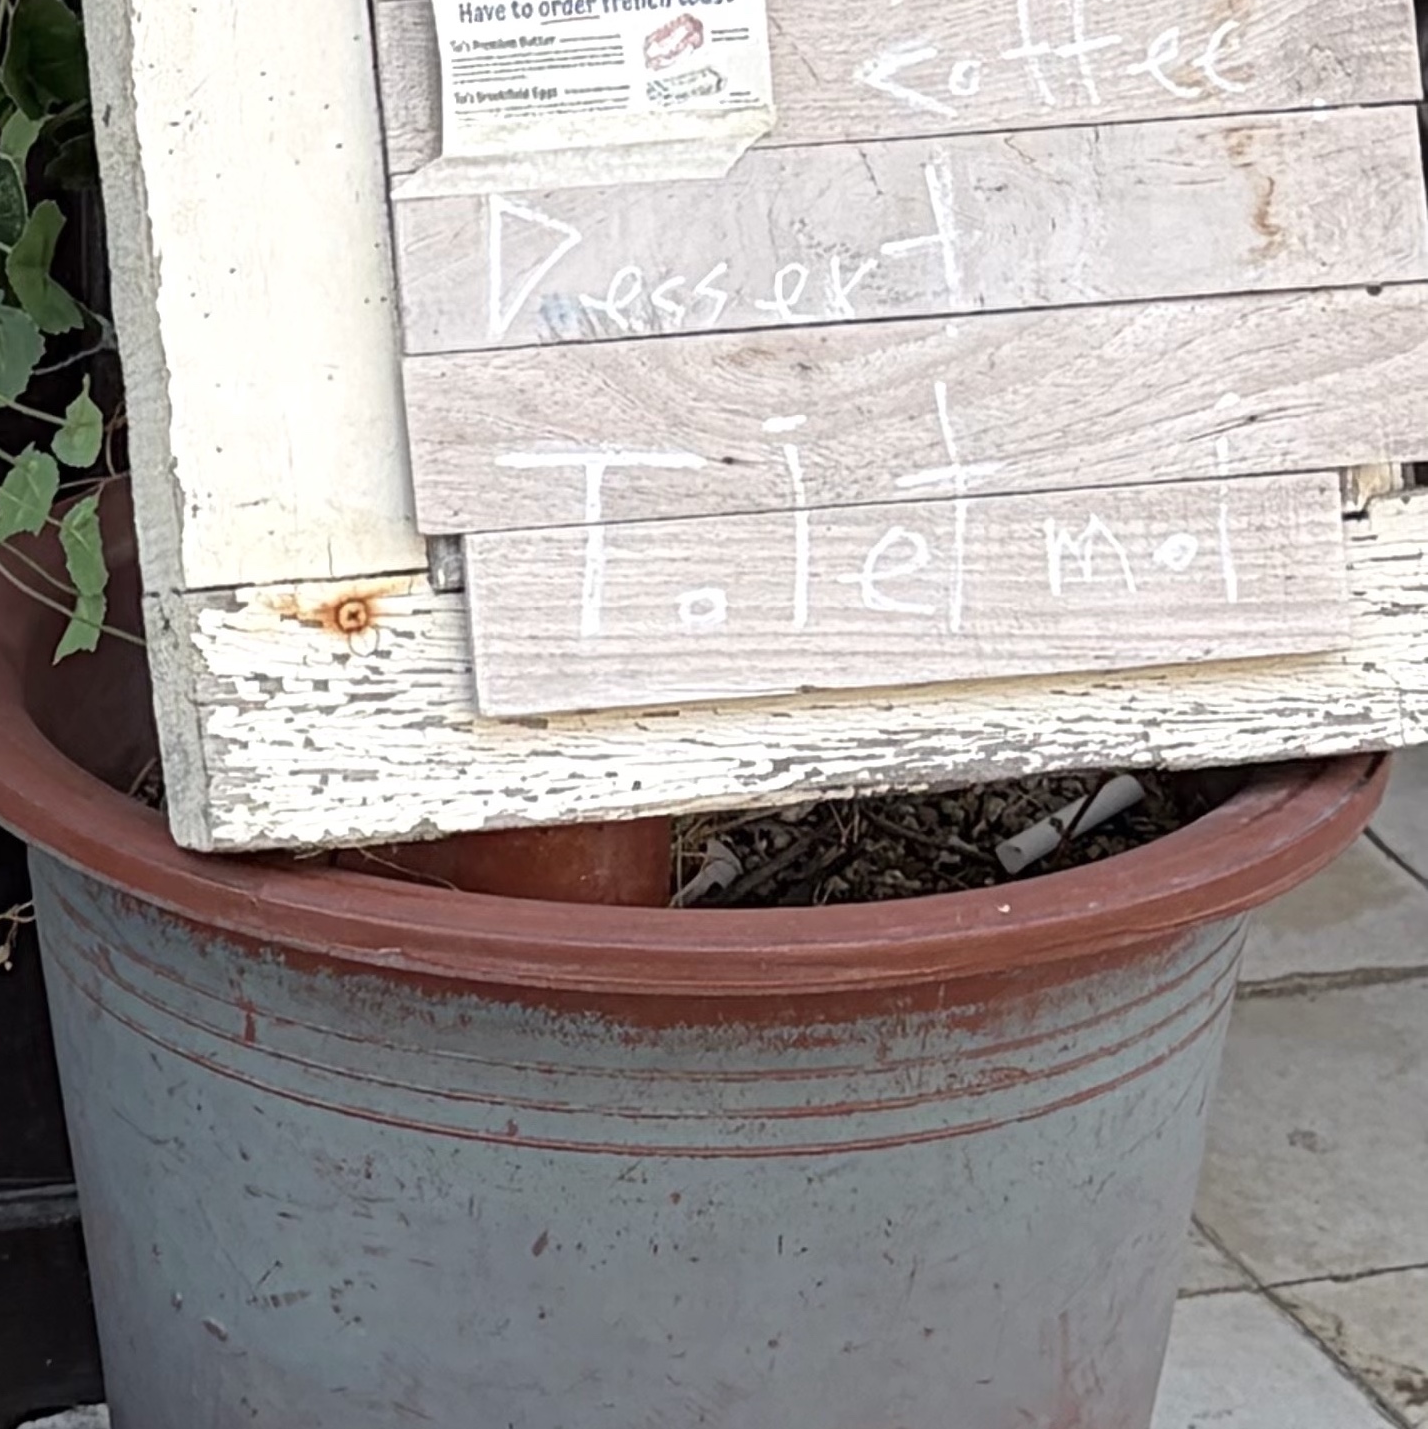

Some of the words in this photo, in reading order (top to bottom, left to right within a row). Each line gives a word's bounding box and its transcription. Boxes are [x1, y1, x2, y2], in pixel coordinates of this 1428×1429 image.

[458, 2, 506, 24] Have
[511, 0, 534, 20] to
[487, 149, 973, 340] Dessert
